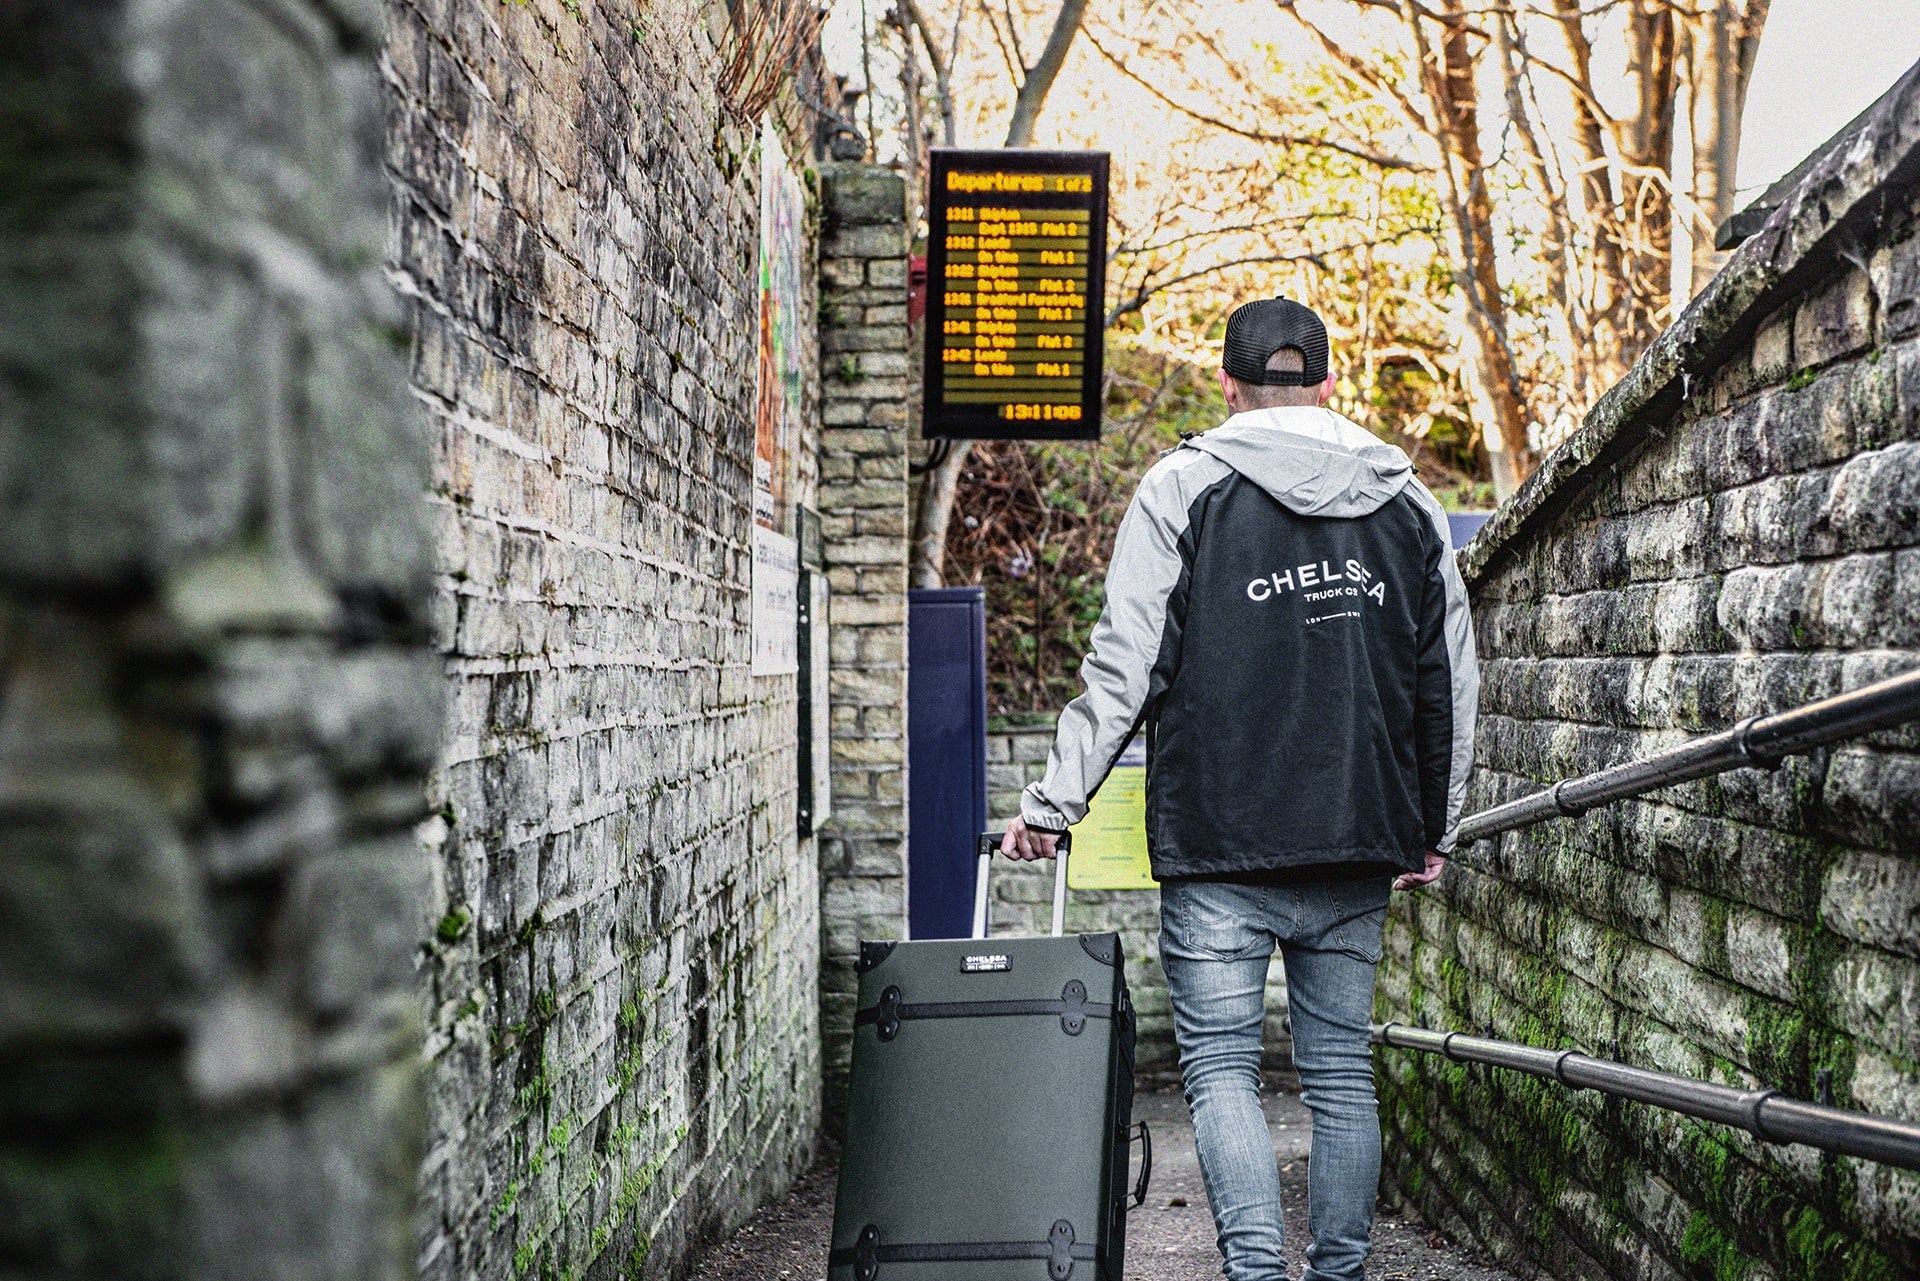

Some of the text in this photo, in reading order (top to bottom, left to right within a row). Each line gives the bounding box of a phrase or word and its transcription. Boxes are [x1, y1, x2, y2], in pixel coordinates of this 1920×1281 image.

[947, 171, 1044, 193] Departures
[1247, 559, 1386, 607] CHELSEA
[1304, 587, 1343, 602] TRUCK
